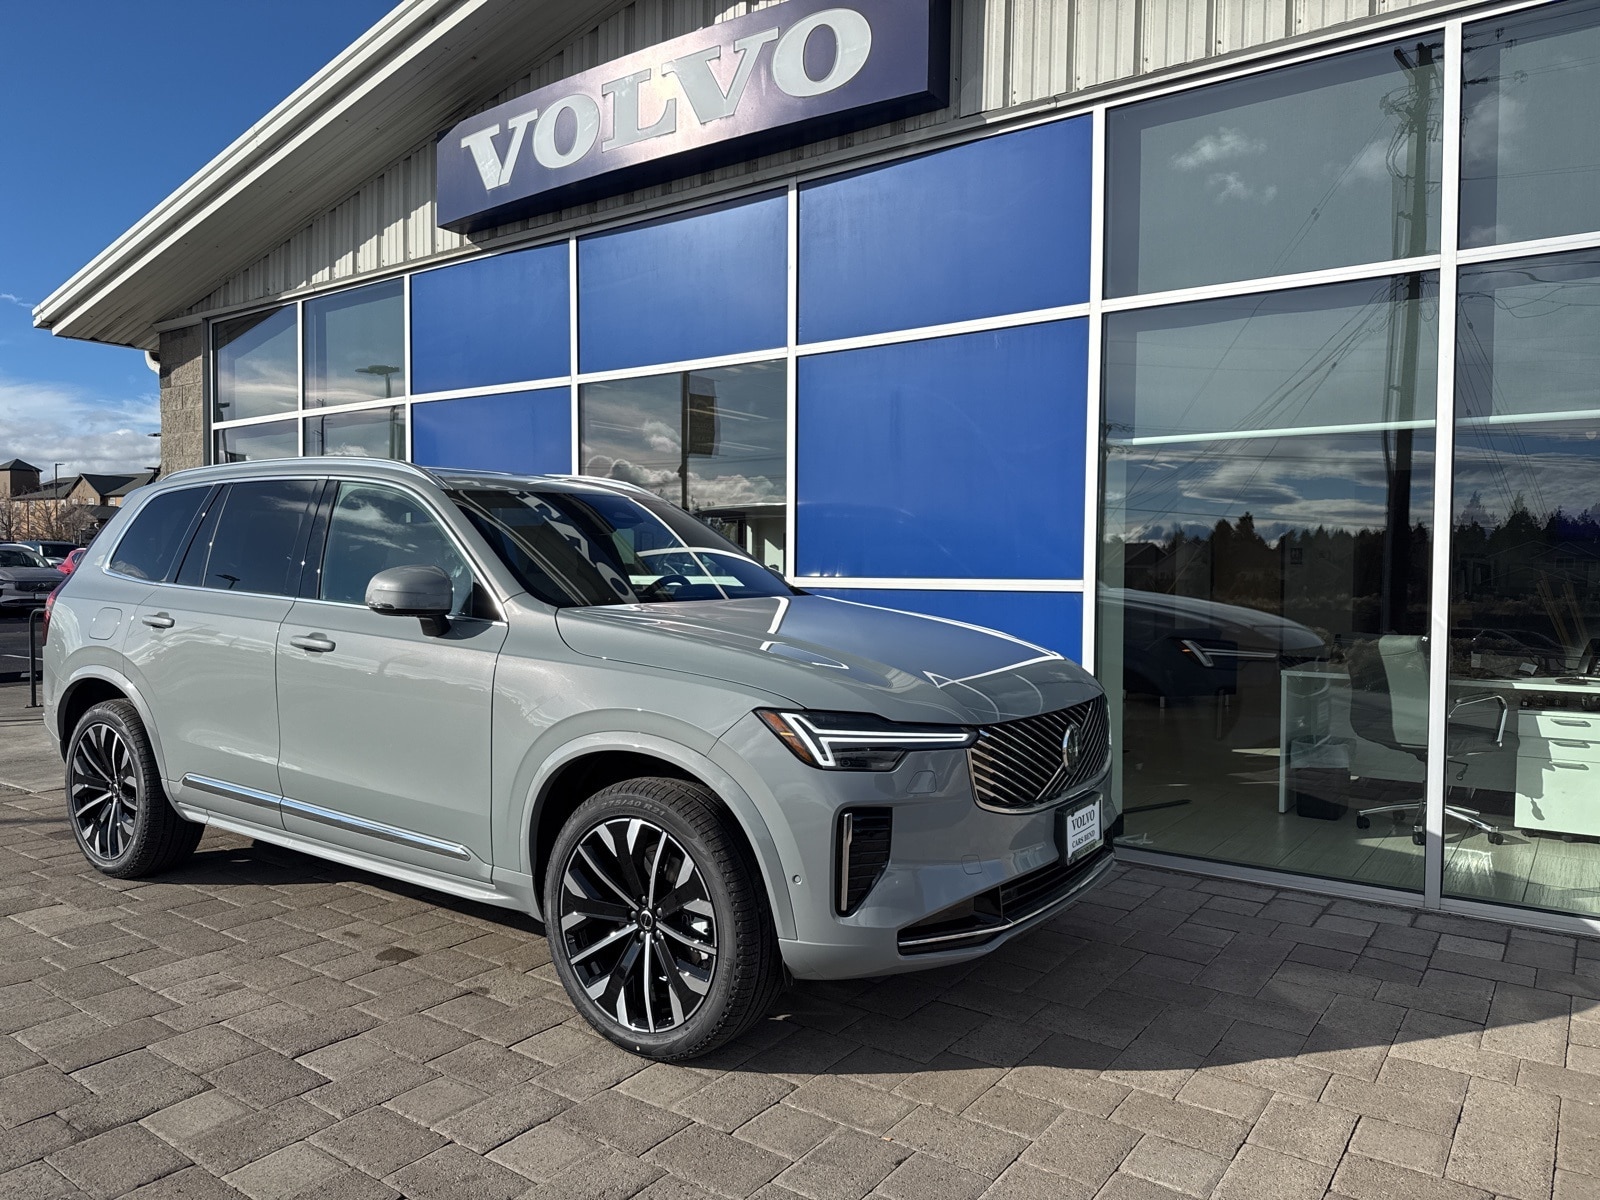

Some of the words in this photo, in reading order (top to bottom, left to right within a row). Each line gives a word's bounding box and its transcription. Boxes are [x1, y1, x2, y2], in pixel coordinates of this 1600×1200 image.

[461, 7, 872, 191] VOLVO
[1071, 809, 1095, 831] VOLVO
[1072, 835, 1084, 848] CARS
